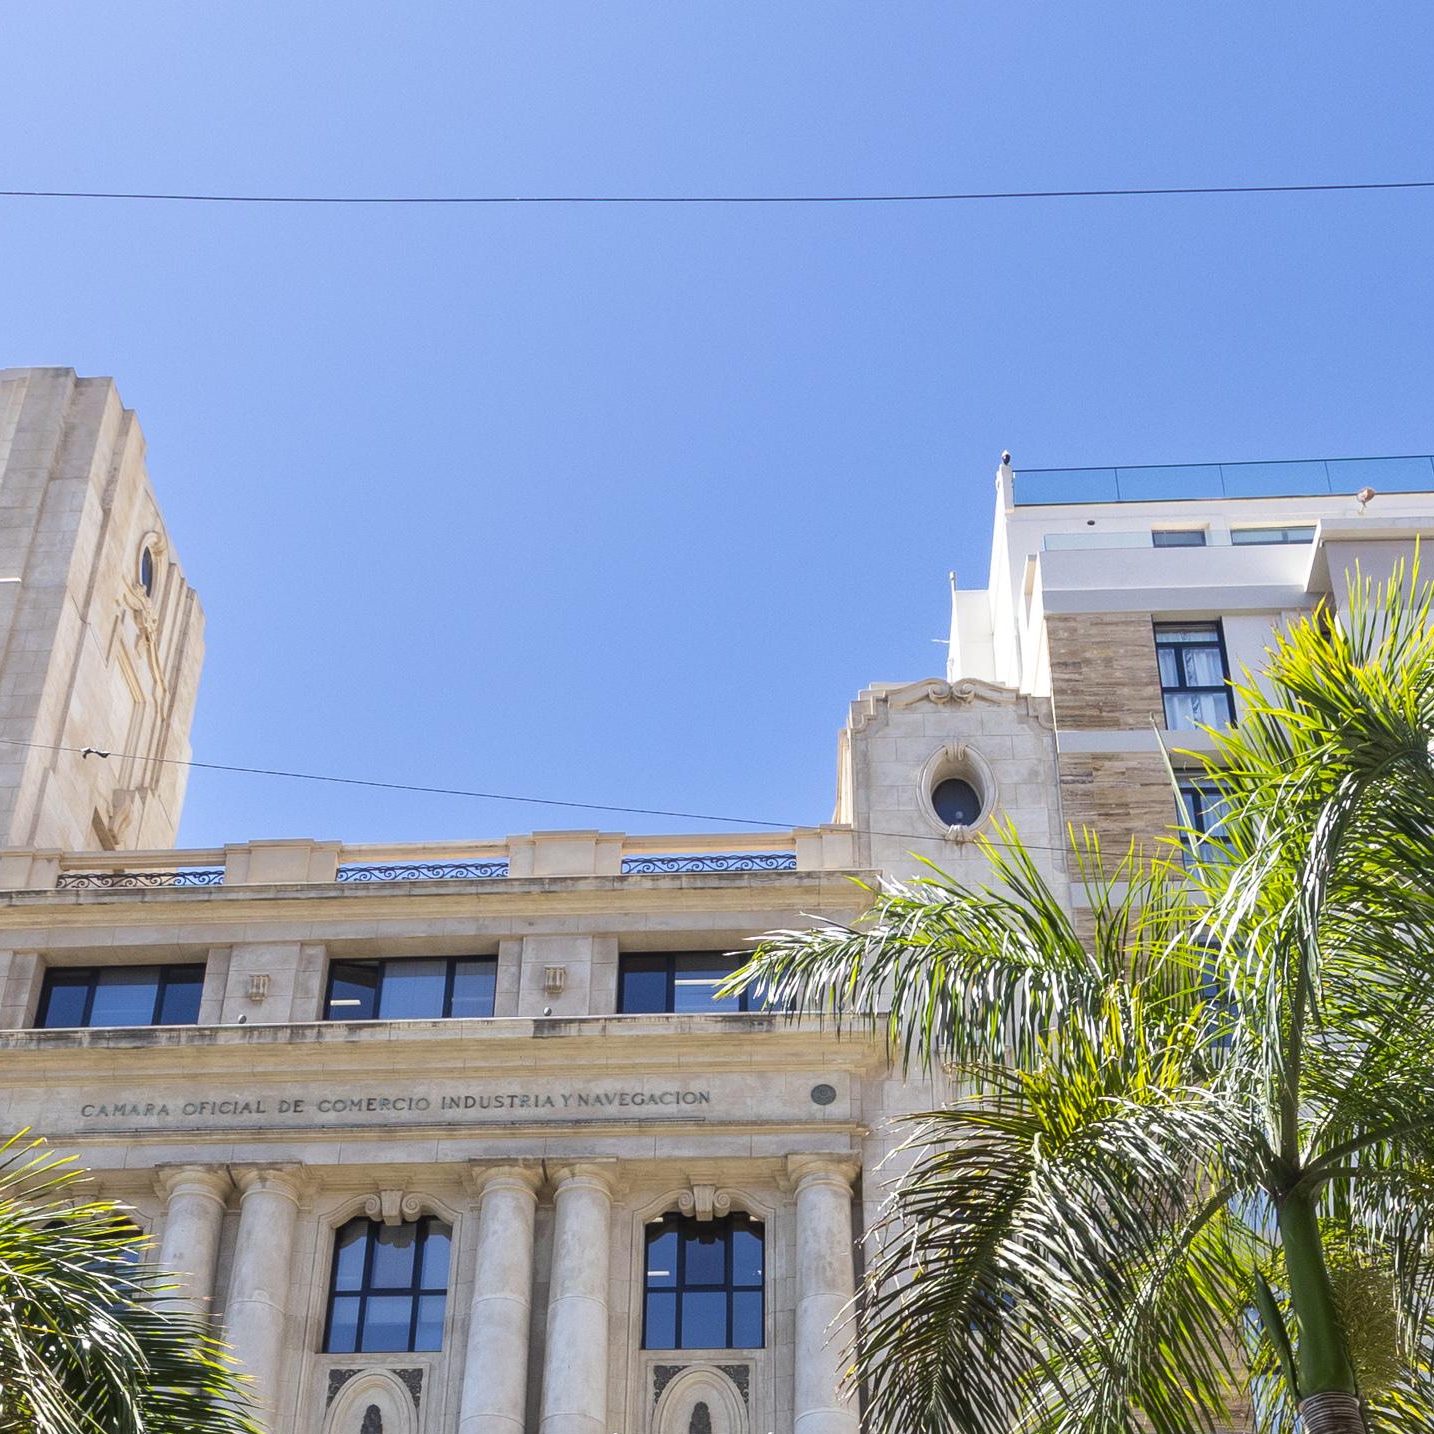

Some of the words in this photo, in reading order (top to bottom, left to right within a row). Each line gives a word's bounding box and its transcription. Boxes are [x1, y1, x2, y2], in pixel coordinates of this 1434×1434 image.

[81, 1103, 169, 1117] CAMARA
[182, 1101, 266, 1115] OFICIAL
[279, 1100, 304, 1113] DE
[318, 1097, 431, 1113] COMERCIO
[441, 1096, 556, 1111] INDUSTRIA
[560, 1095, 577, 1107] Y
[577, 1091, 711, 1107] NAVEGACION
